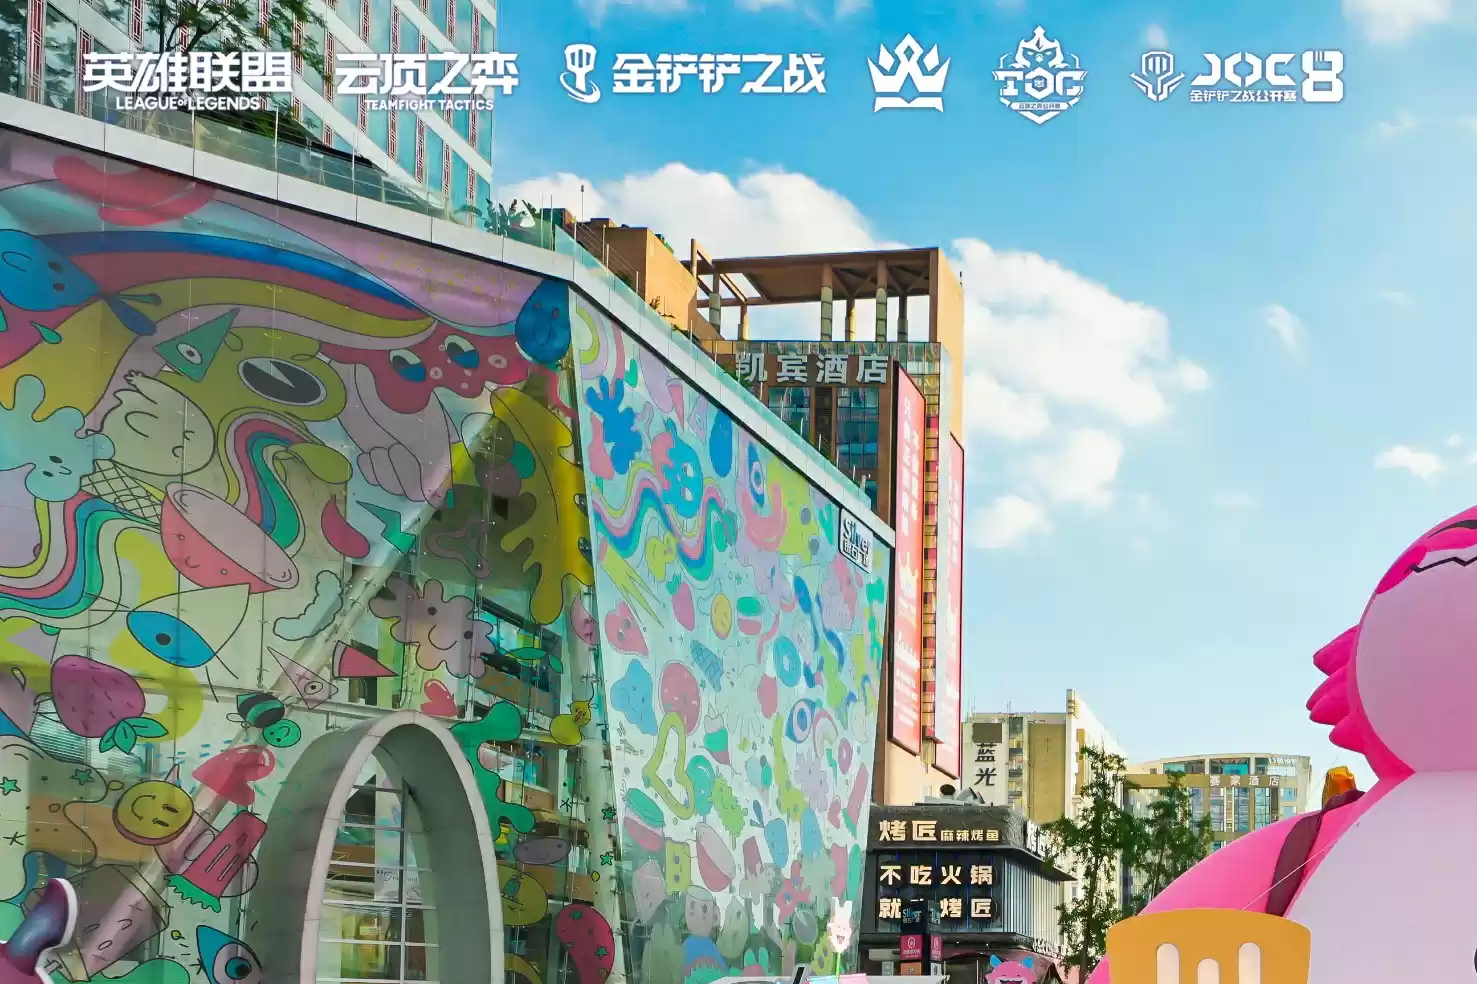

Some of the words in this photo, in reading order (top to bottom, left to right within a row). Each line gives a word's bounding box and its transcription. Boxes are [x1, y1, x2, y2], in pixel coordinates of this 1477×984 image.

[736, 352, 889, 384] 凯宾酒店
[975, 743, 997, 786] 蓝光
[879, 820, 938, 841] 烤匠
[941, 830, 999, 841] 麻辣烤鱼
[880, 865, 993, 885] 不吃火锅
[879, 898, 992, 918] 就烤匠
